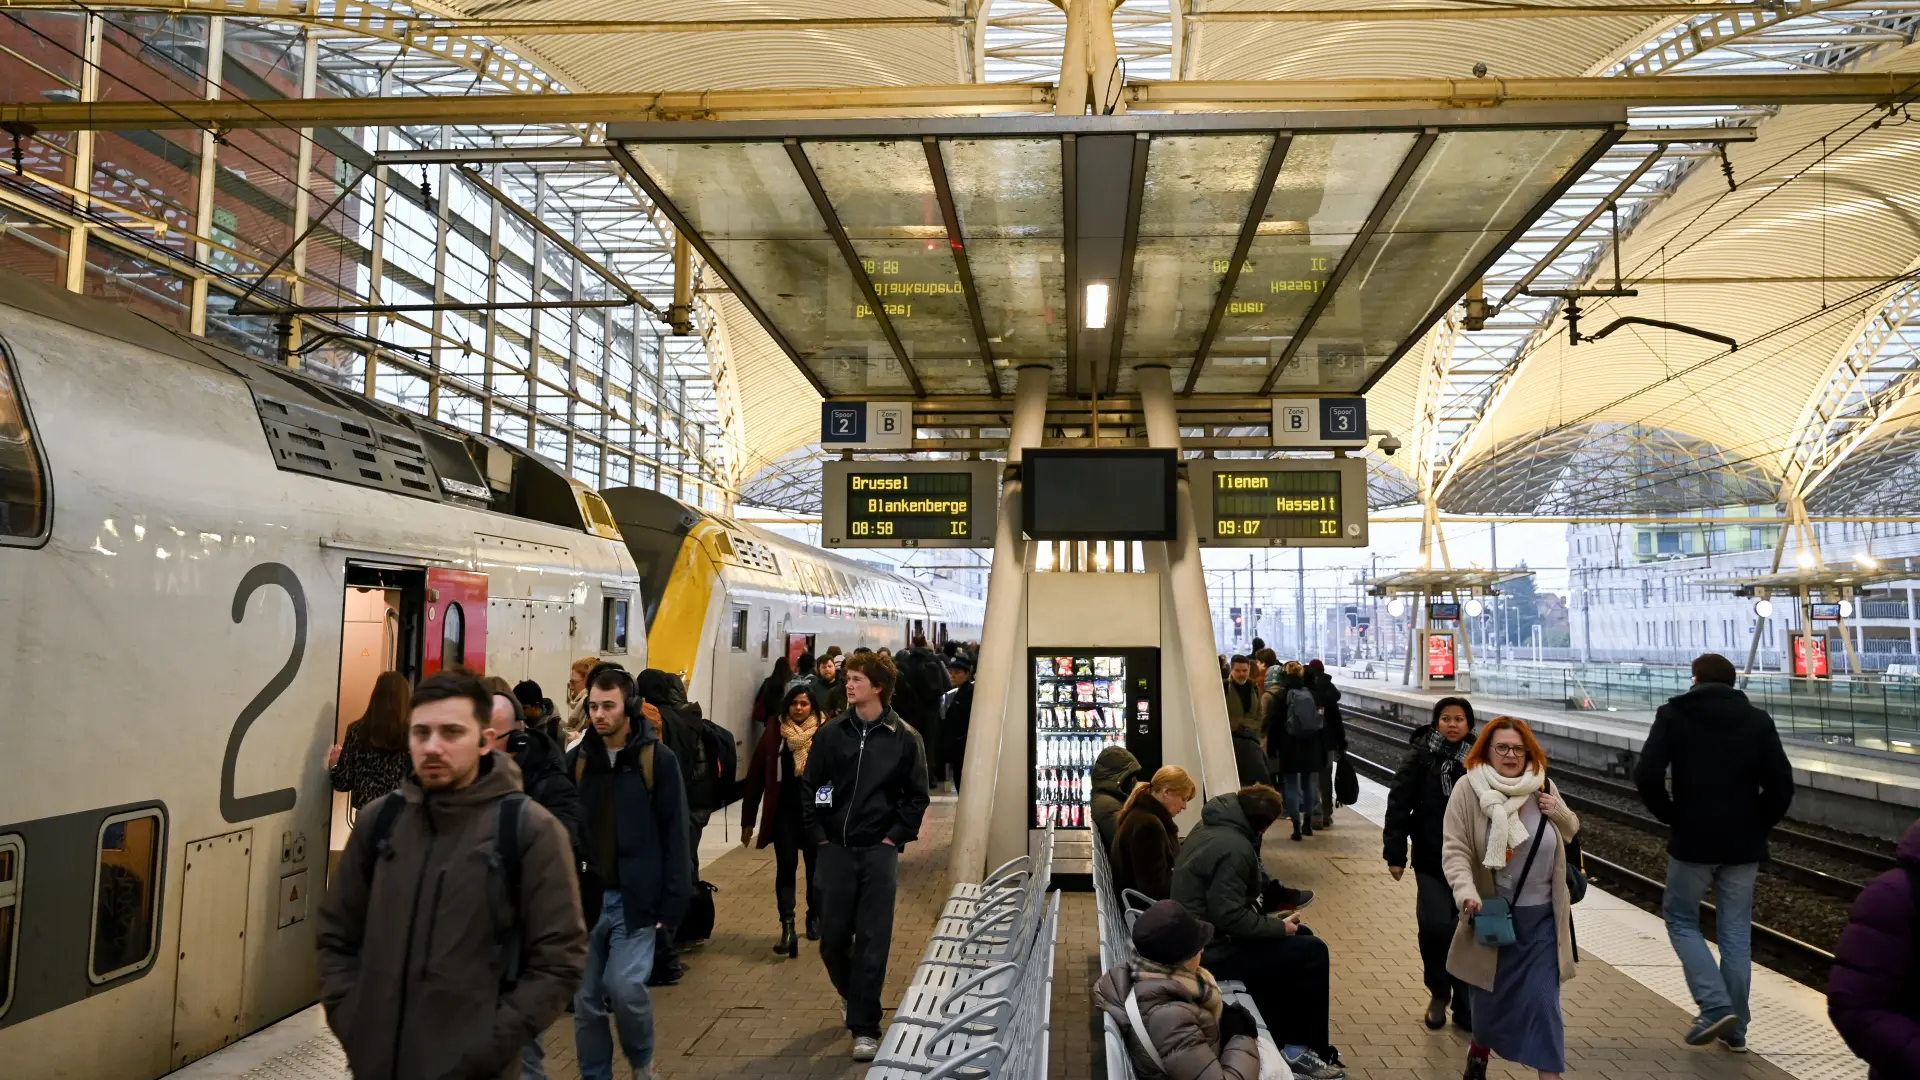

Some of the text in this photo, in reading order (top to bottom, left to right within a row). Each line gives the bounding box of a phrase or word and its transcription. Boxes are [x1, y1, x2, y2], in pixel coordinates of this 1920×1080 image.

[1333, 408, 1352, 416] Spoor
[839, 418, 849, 433] 2
[884, 418, 894, 431] B
[1291, 415, 1302, 429] B
[1338, 415, 1348, 431] 3
[852, 476, 908, 490] Brussel
[1217, 474, 1268, 489] Tienen
[868, 499, 967, 515] Blankenberge
[1276, 497, 1335, 511] Hasselt
[852, 522, 967, 535] 08:58 IC
[1218, 520, 1337, 534] 09:07 IC
[219, 562, 307, 823] 2
